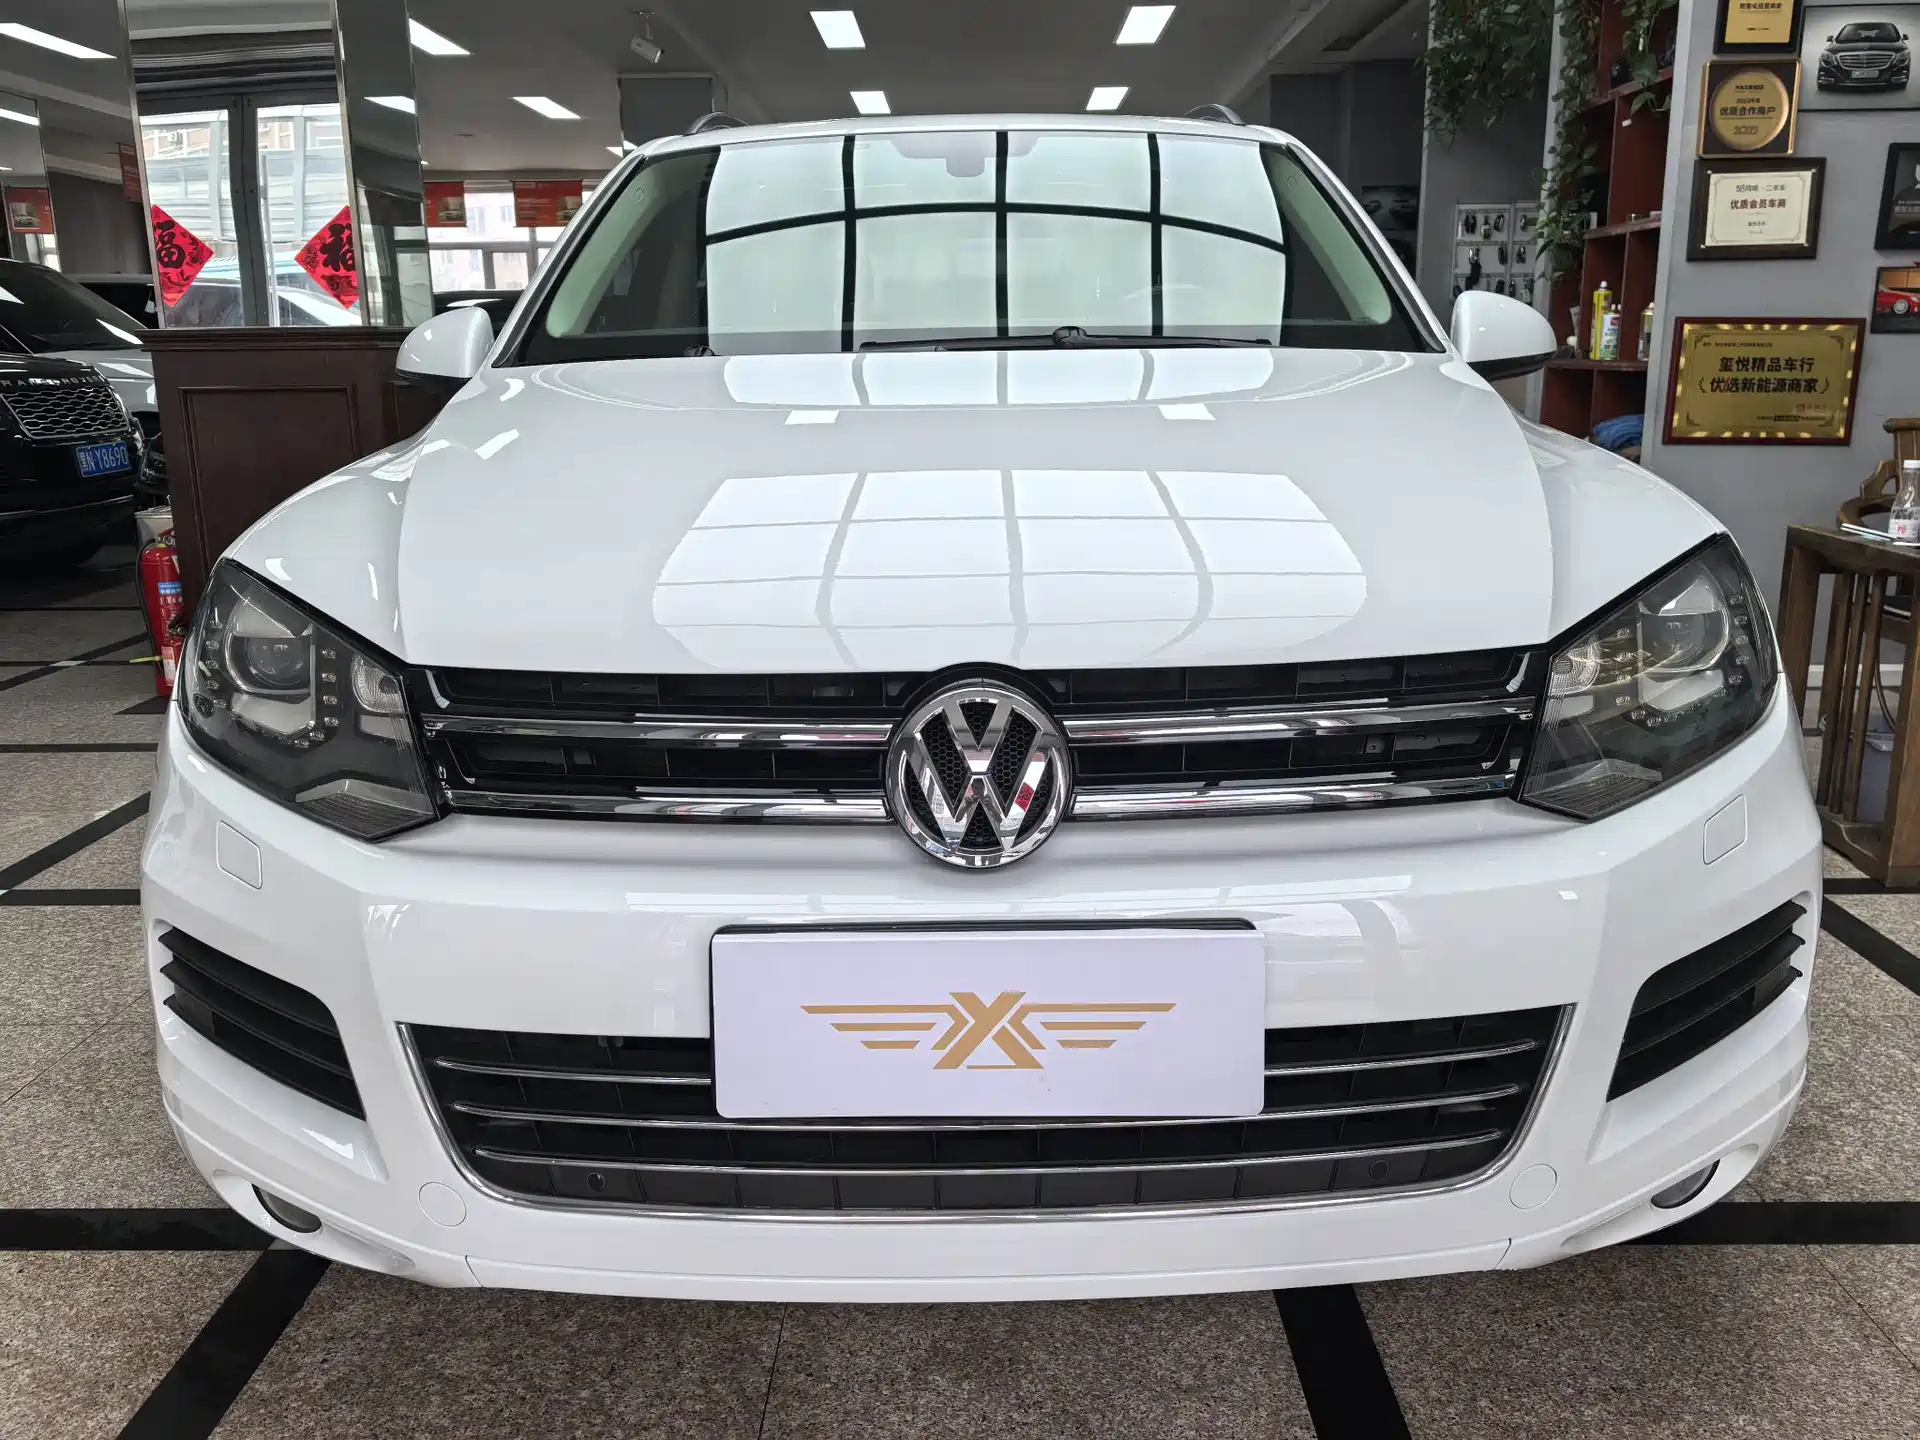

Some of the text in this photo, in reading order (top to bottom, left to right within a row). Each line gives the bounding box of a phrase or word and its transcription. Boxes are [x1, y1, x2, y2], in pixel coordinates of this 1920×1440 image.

[1730, 198, 1786, 210] 优质会员车商
[1719, 356, 1815, 373] 玺悦精品车行
[1710, 377, 1819, 393] 优选新能源商家
